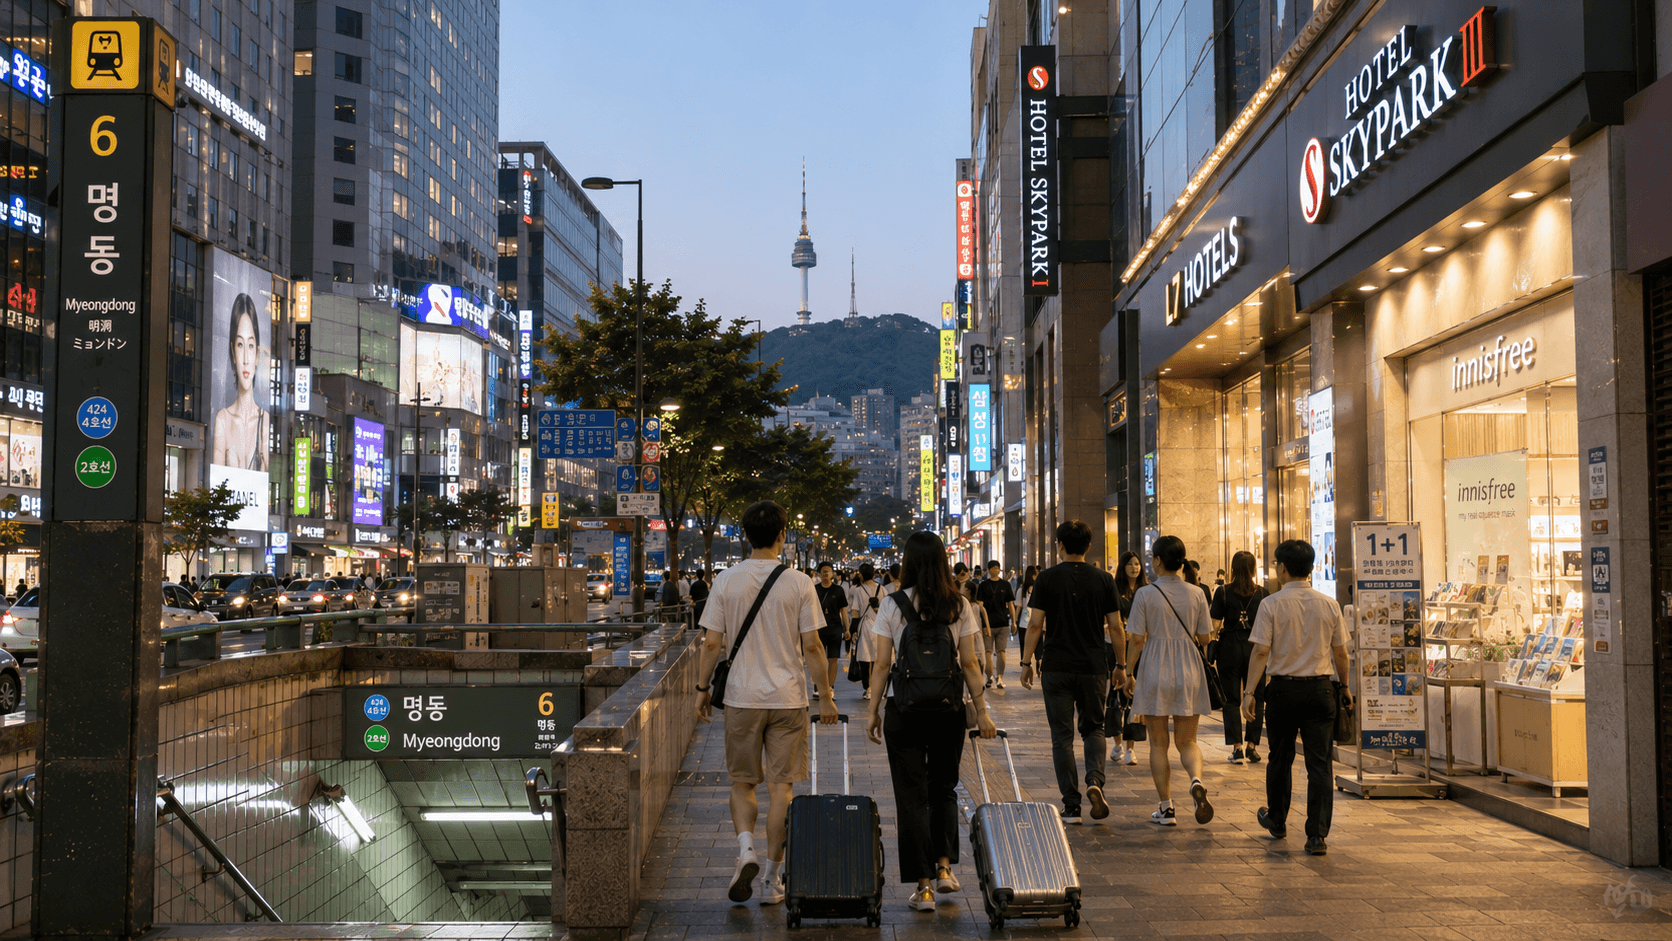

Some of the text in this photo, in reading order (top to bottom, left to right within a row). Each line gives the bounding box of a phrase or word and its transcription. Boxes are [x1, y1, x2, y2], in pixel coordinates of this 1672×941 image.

[1344, 25, 1413, 120] HOTEL
[1329, 35, 1457, 198] SKYPARK
[89, 115, 118, 157] 6
[1030, 98, 1047, 172] HOTEL
[84, 182, 120, 276] 명동
[1030, 177, 1049, 276] SKYPARK
[1165, 215, 1239, 327] L7 HOTELS
[65, 297, 136, 314] Myeongdong
[73, 337, 127, 350] ミョンドン
[1451, 335, 1535, 391] innisfree
[81, 416, 112, 429] 4호선
[86, 404, 108, 415] 424
[80, 460, 111, 474] 2호선
[229, 490, 259, 507] HANEL
[1457, 477, 1516, 505] innisfree
[1366, 532, 1408, 556] 1+1
[403, 695, 448, 722] 명동
[538, 691, 555, 716] 6
[403, 733, 501, 752] Myeongdong
